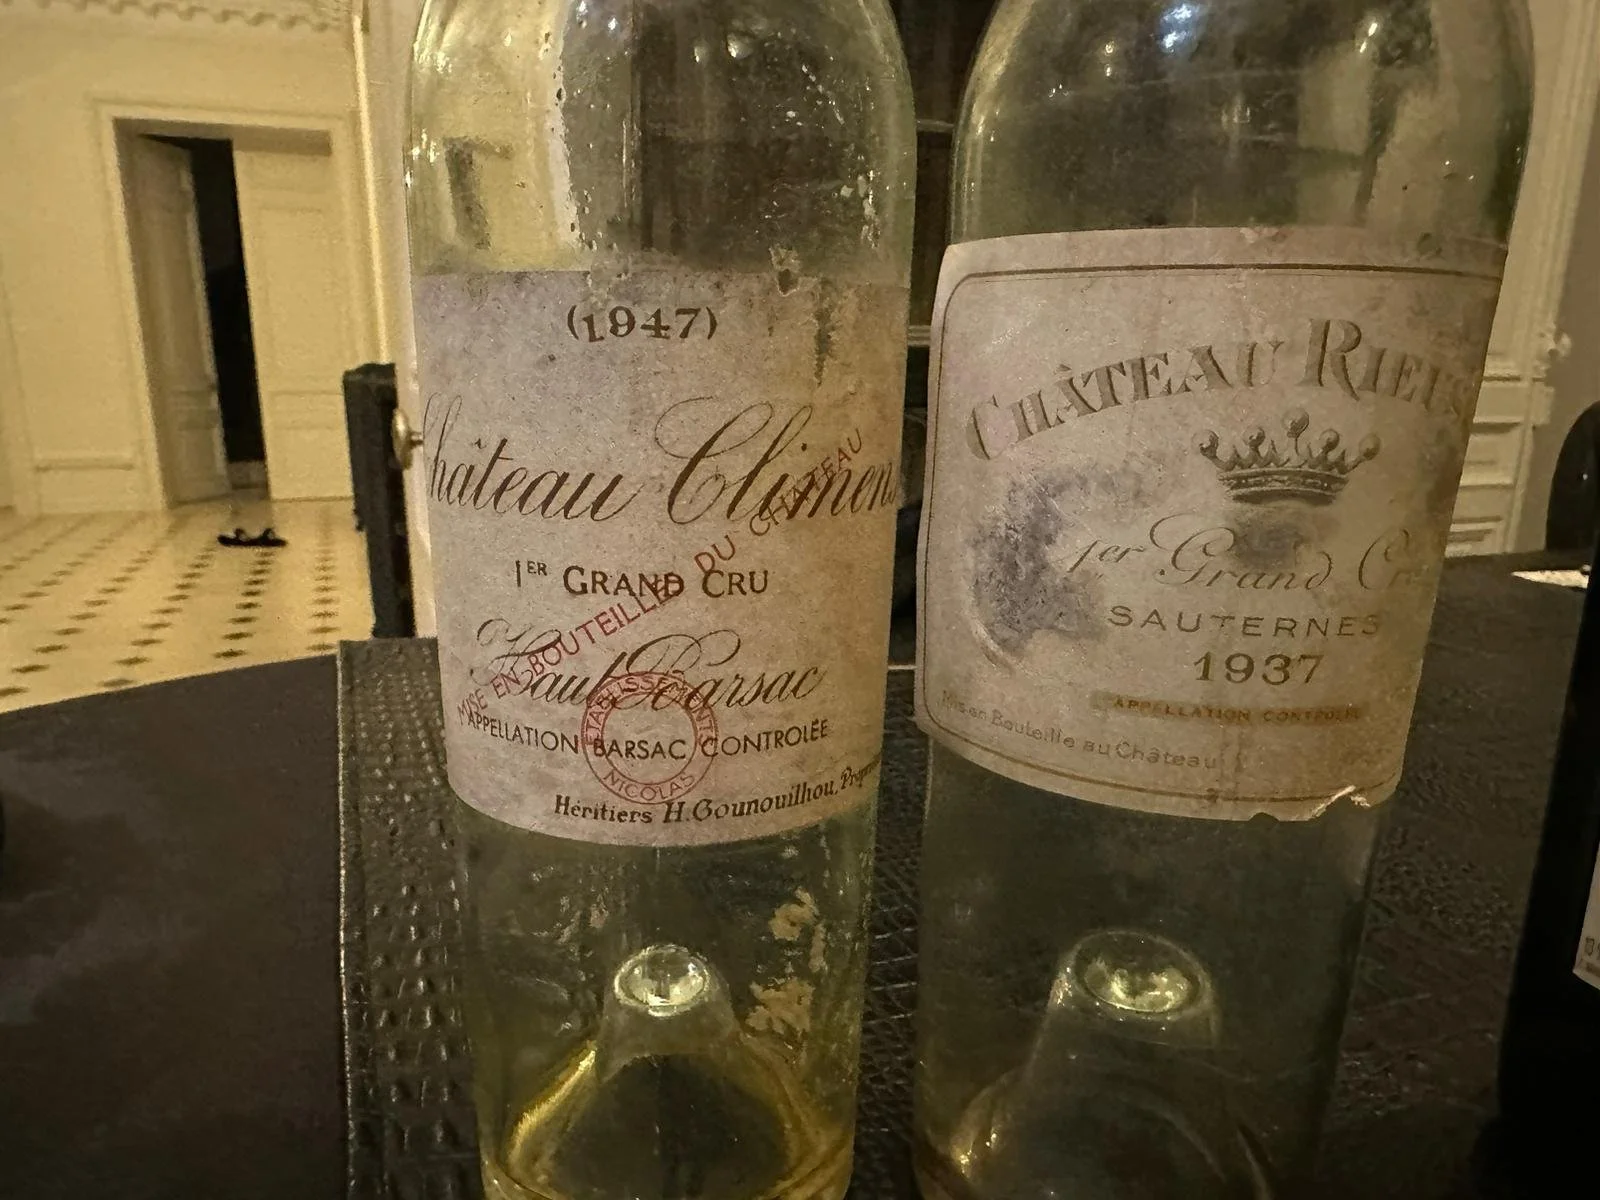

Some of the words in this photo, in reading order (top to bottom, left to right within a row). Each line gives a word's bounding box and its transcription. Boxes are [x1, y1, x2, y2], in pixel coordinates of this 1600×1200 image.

[566, 305, 718, 343] (1947)
[1150, 512, 1334, 591] Grand
[562, 566, 685, 598] GRAND
[701, 569, 769, 599] CRU
[457, 688, 489, 727] MISE
[490, 672, 522, 699] EN
[527, 572, 685, 677] BOUTEILLE
[694, 534, 737, 574] DU
[1107, 605, 1383, 638] SAUTERNES
[469, 617, 628, 709] Haut
[614, 628, 829, 711] Barsac
[1193, 651, 1325, 686] 1937
[1112, 694, 1251, 723] APPELLATION
[467, 709, 579, 755] APPELLATION
[592, 738, 687, 760] BARSAC
[700, 717, 829, 758] CONTROLÉE
[991, 708, 1076, 749] Bouteille
[1082, 739, 1110, 756] au
[1114, 741, 1218, 770] Château
[602, 766, 695, 801] NICOLAS
[553, 794, 654, 824] Héritiers
